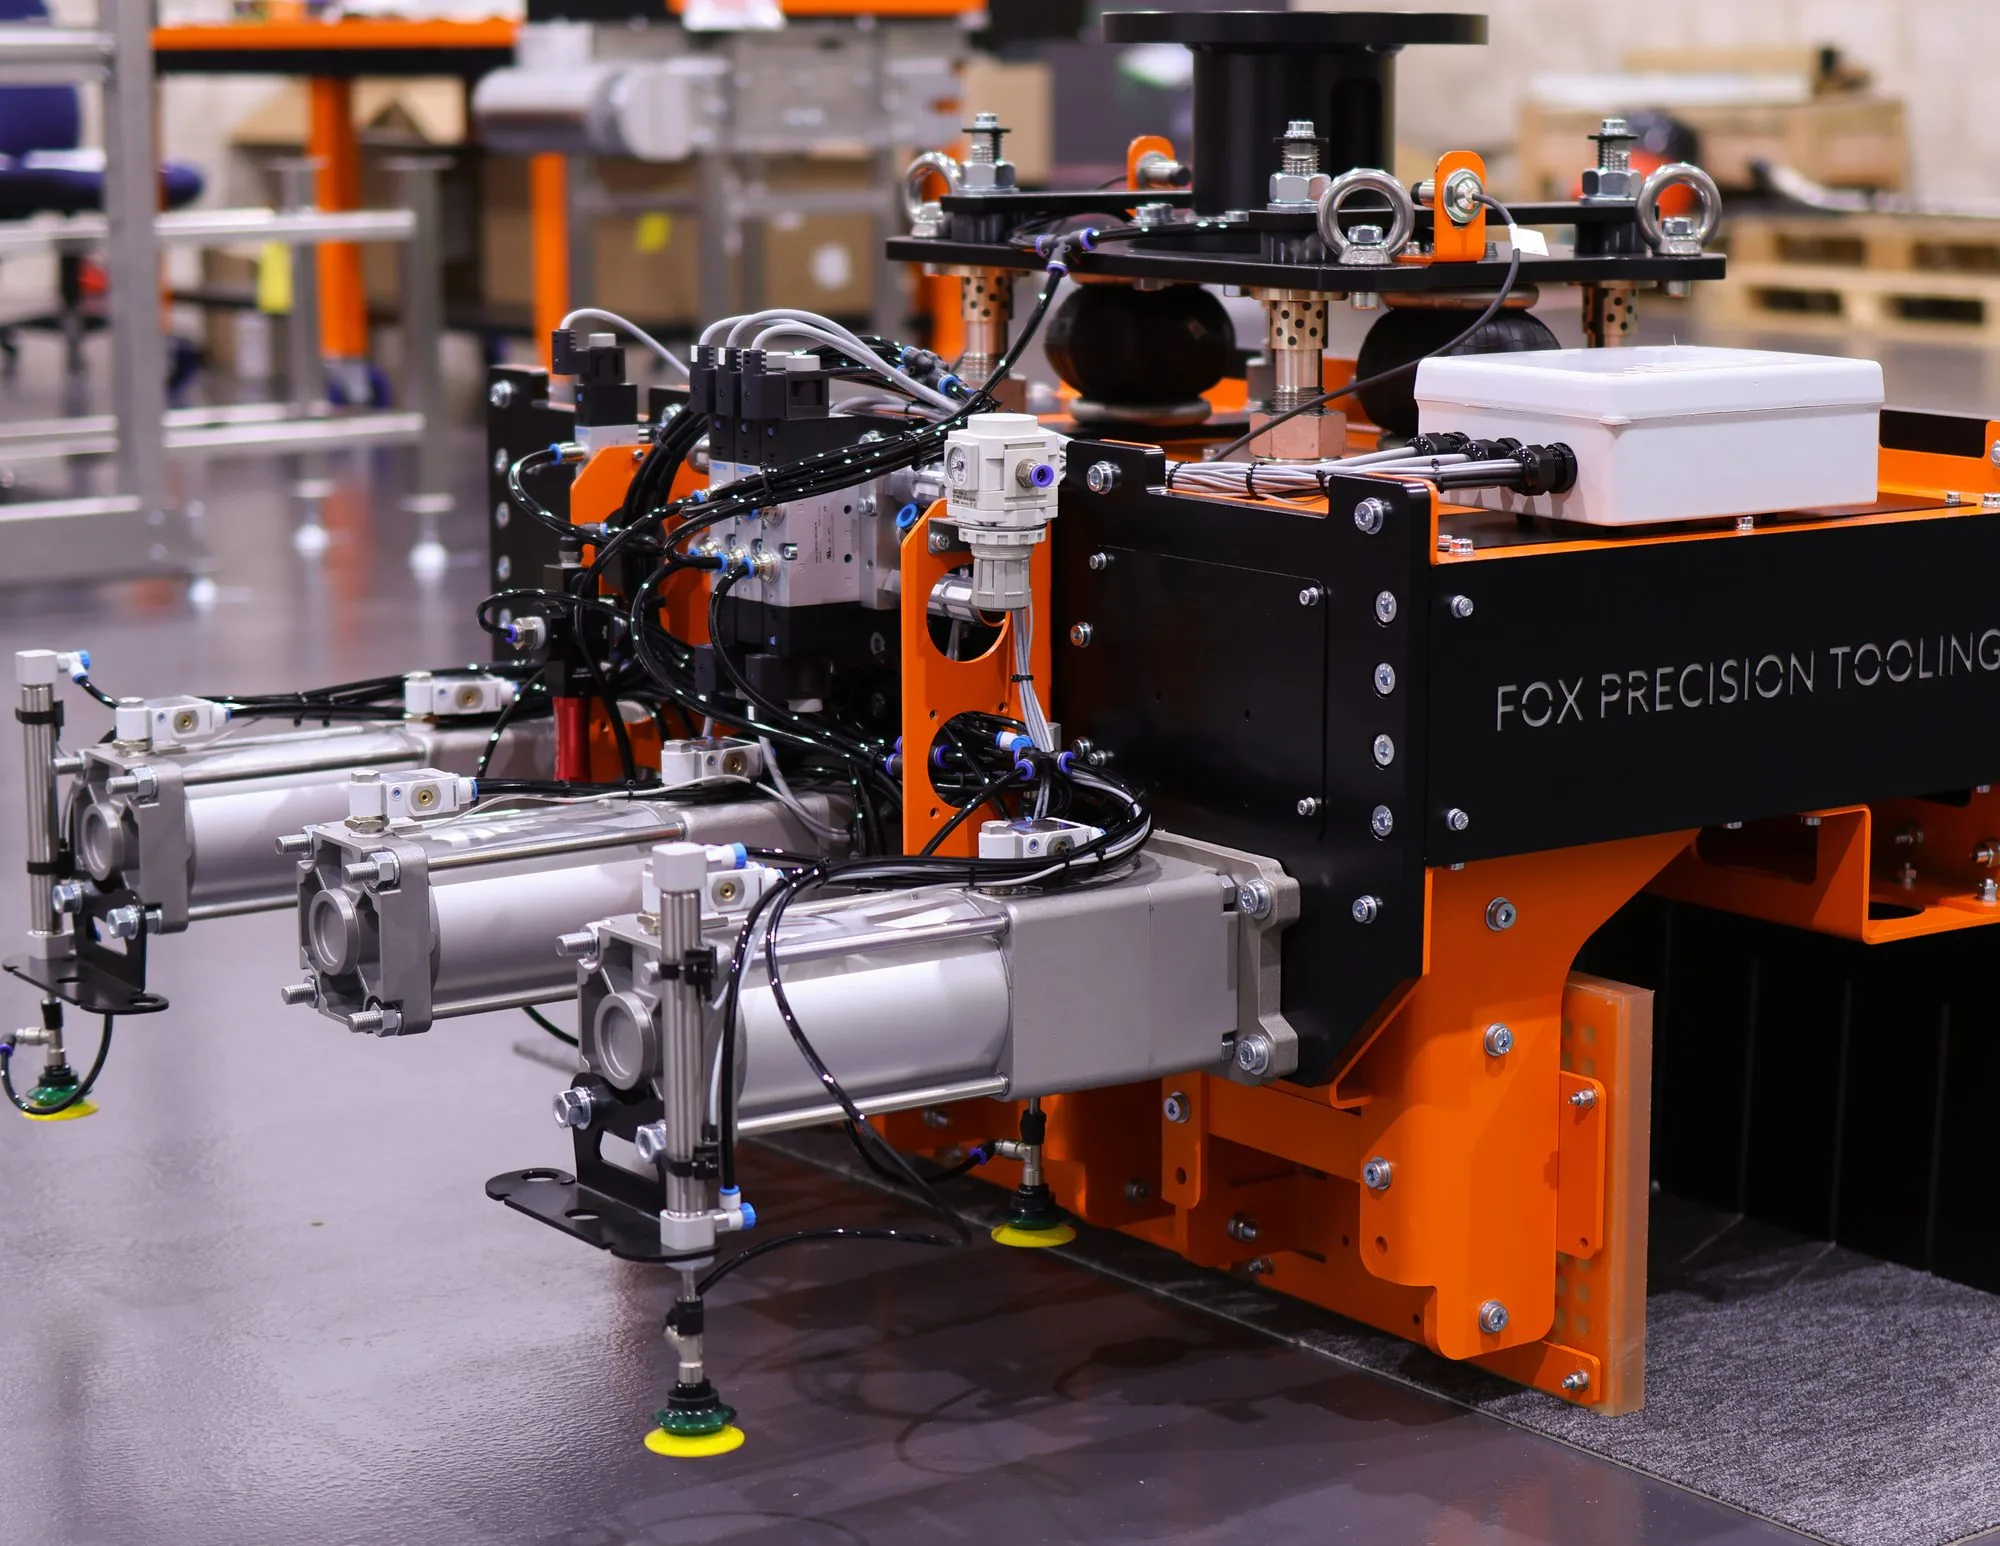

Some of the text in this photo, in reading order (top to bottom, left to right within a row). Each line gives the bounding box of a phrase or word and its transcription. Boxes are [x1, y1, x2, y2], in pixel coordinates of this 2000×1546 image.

[1496, 628, 2000, 732] FOX PRECISION TOOLING
